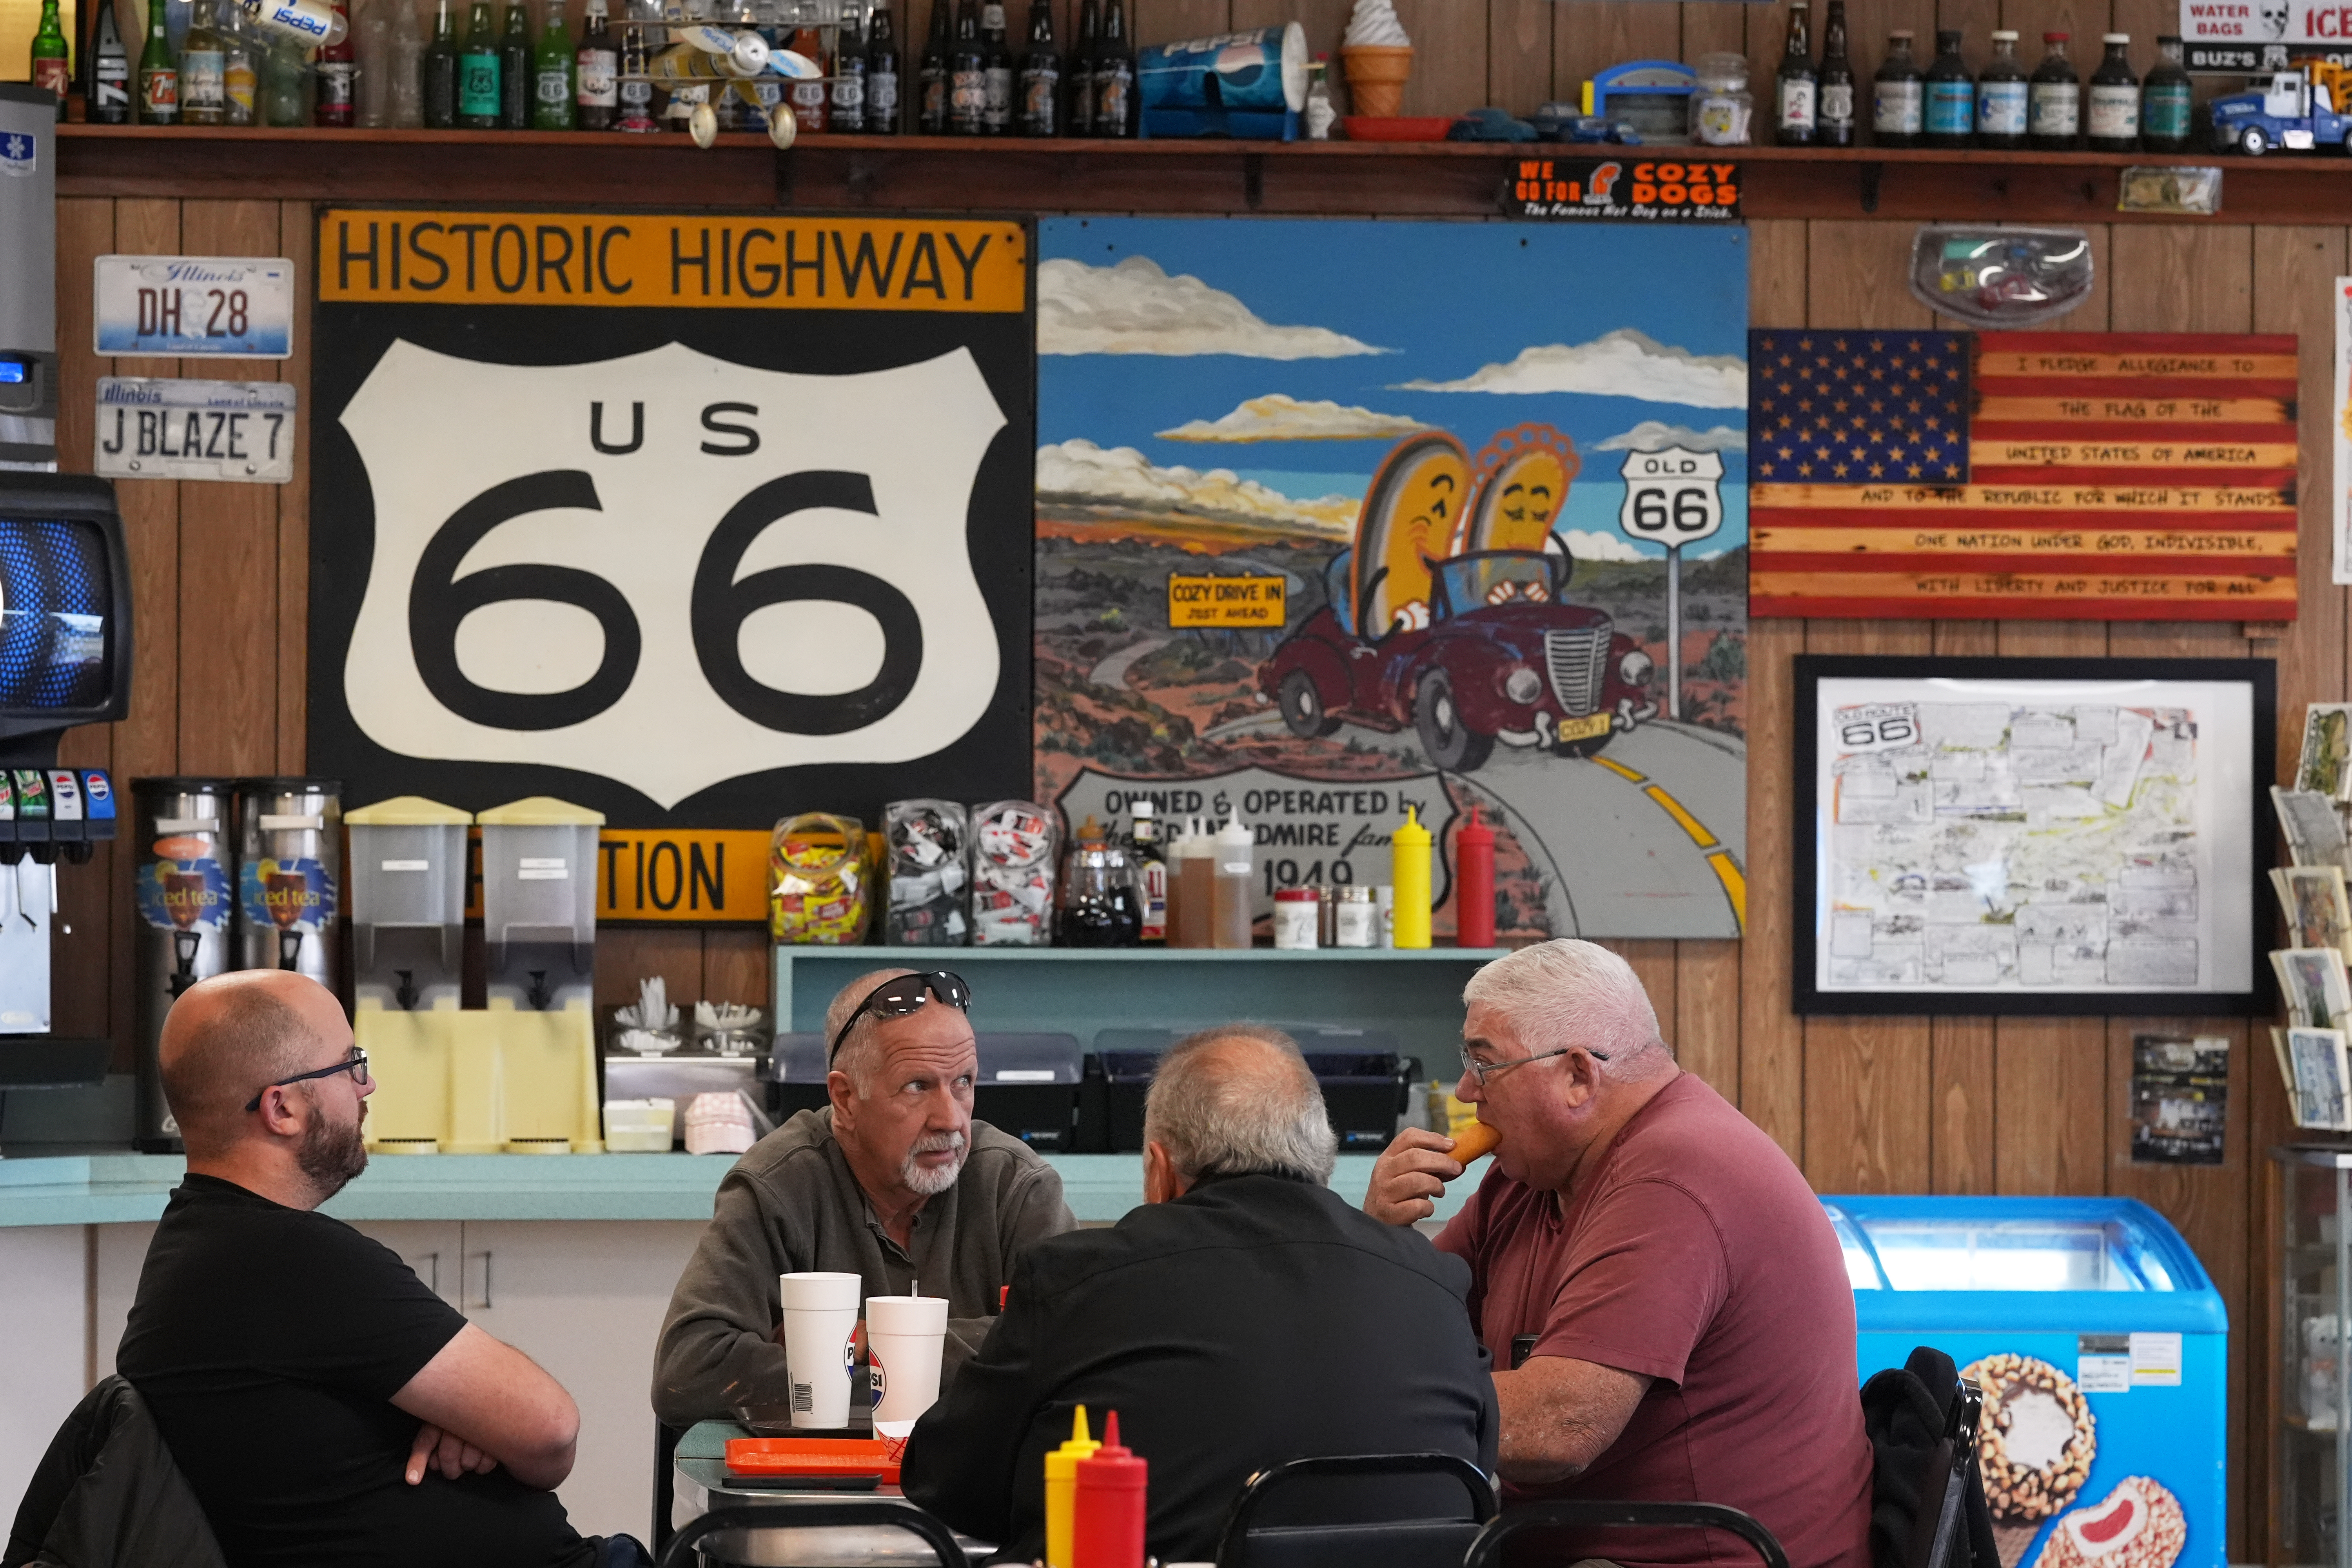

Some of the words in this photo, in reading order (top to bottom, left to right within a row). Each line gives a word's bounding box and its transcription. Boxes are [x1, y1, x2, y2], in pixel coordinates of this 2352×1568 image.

[2190, 4, 2249, 18] WATER
[272, 7, 327, 36] PEPSI
[2197, 22, 2243, 35] BAGS
[2192, 51, 2256, 67] BUZ'S
[1519, 161, 1554, 180] WE
[1633, 162, 1736, 183] COZY
[1516, 180, 1540, 201] GO
[1546, 180, 1581, 202] FOR
[1632, 182, 1738, 205] DOGS
[1524, 201, 1548, 216] The
[338, 221, 632, 294] HISTORIC
[671, 227, 993, 301] HIGHWAY
[167, 262, 246, 282] Illinois
[137, 287, 181, 337] DH
[205, 289, 248, 338] 28
[2040, 359, 2098, 374] PLEDGE
[2118, 359, 2216, 374] ALLEGIANCE
[2234, 359, 2254, 372] TO
[105, 383, 162, 404] Illinois
[2059, 401, 2092, 416] THE
[2105, 402, 2147, 418] FLAG
[2156, 402, 2176, 417] OF
[2191, 403, 2223, 418] THE
[103, 408, 124, 455] J
[137, 410, 249, 459] BLAZE
[263, 413, 284, 459] 7
[2005, 446, 2071, 461] UNITED
[2081, 446, 2140, 461] STATES
[2152, 448, 2173, 461] OF
[2184, 448, 2256, 461] AMERICA
[1644, 459, 1697, 474] OLD
[1861, 490, 1894, 503] AND
[1984, 489, 2062, 506] REPUBLIC
[2074, 490, 2105, 505] FOR
[2115, 490, 2168, 506] WHICH
[2180, 490, 2200, 506] IT
[1633, 488, 1709, 532] 66
[1915, 534, 1947, 548] ONE
[1957, 534, 2022, 550] NATION
[2031, 534, 2082, 550] UNDER
[1173, 584, 1212, 602] COZY
[1216, 584, 1259, 601] DRIVE
[1265, 584, 1281, 601] IN
[1916, 578, 1960, 593] WITH
[1975, 579, 2043, 594] LIBERTY
[2055, 579, 2087, 594] AND
[2099, 579, 2169, 595] JUSTICE
[2185, 580, 2215, 595] FOR
[408, 468, 924, 737] 66
[1225, 607, 1269, 620] AHEAD
[1842, 718, 1911, 745] 66
[1105, 789, 1203, 814] OWNED
[1243, 789, 1388, 815] OPERATED
[191, 890, 218, 907] tea
[292, 890, 321, 907] tea
